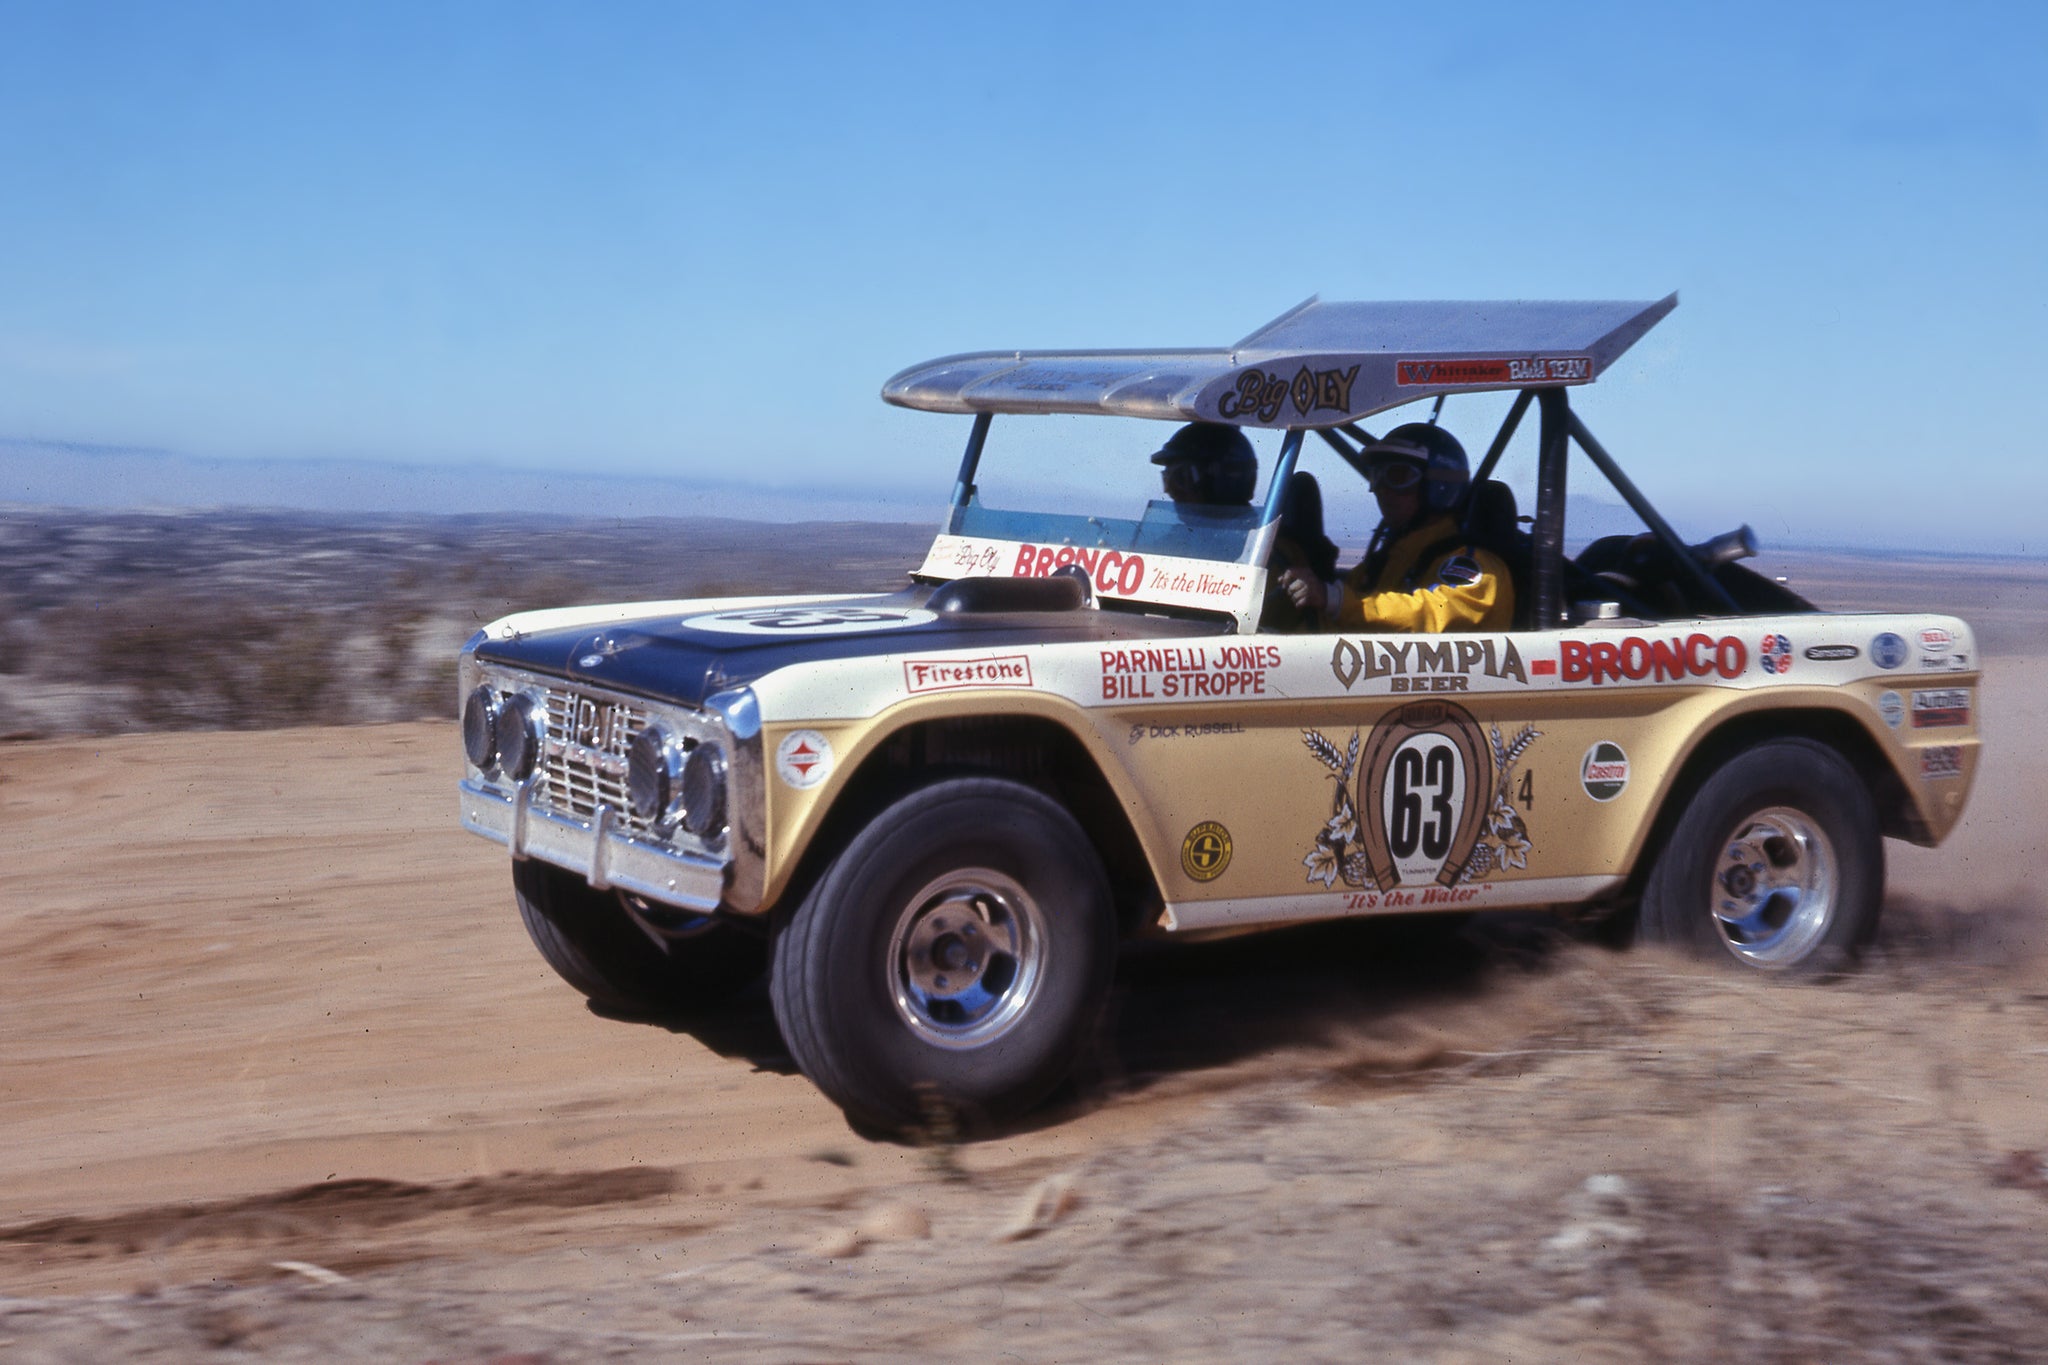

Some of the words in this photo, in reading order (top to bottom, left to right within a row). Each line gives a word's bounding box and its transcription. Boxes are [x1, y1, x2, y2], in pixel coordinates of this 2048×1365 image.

[1549, 358, 1588, 379] TEAM
[1218, 368, 1289, 422] Big
[1291, 363, 1362, 415] OLY
[1171, 571, 1194, 592] the
[1100, 648, 1206, 674] PARNELLI
[1212, 645, 1281, 671] JONES
[1331, 636, 1529, 691] OLYMPIA
[1559, 633, 1748, 685] BRONCO
[912, 663, 1023, 686] Firestone
[1102, 674, 1155, 700] BILL
[1162, 670, 1266, 698] STROPPE
[1390, 675, 1469, 693] BEER
[1150, 725, 1180, 739] DICK
[1184, 721, 1246, 738] RUSSELL
[1390, 744, 1455, 860] 63
[1518, 768, 1535, 812] 4
[1383, 891, 1415, 908] the
